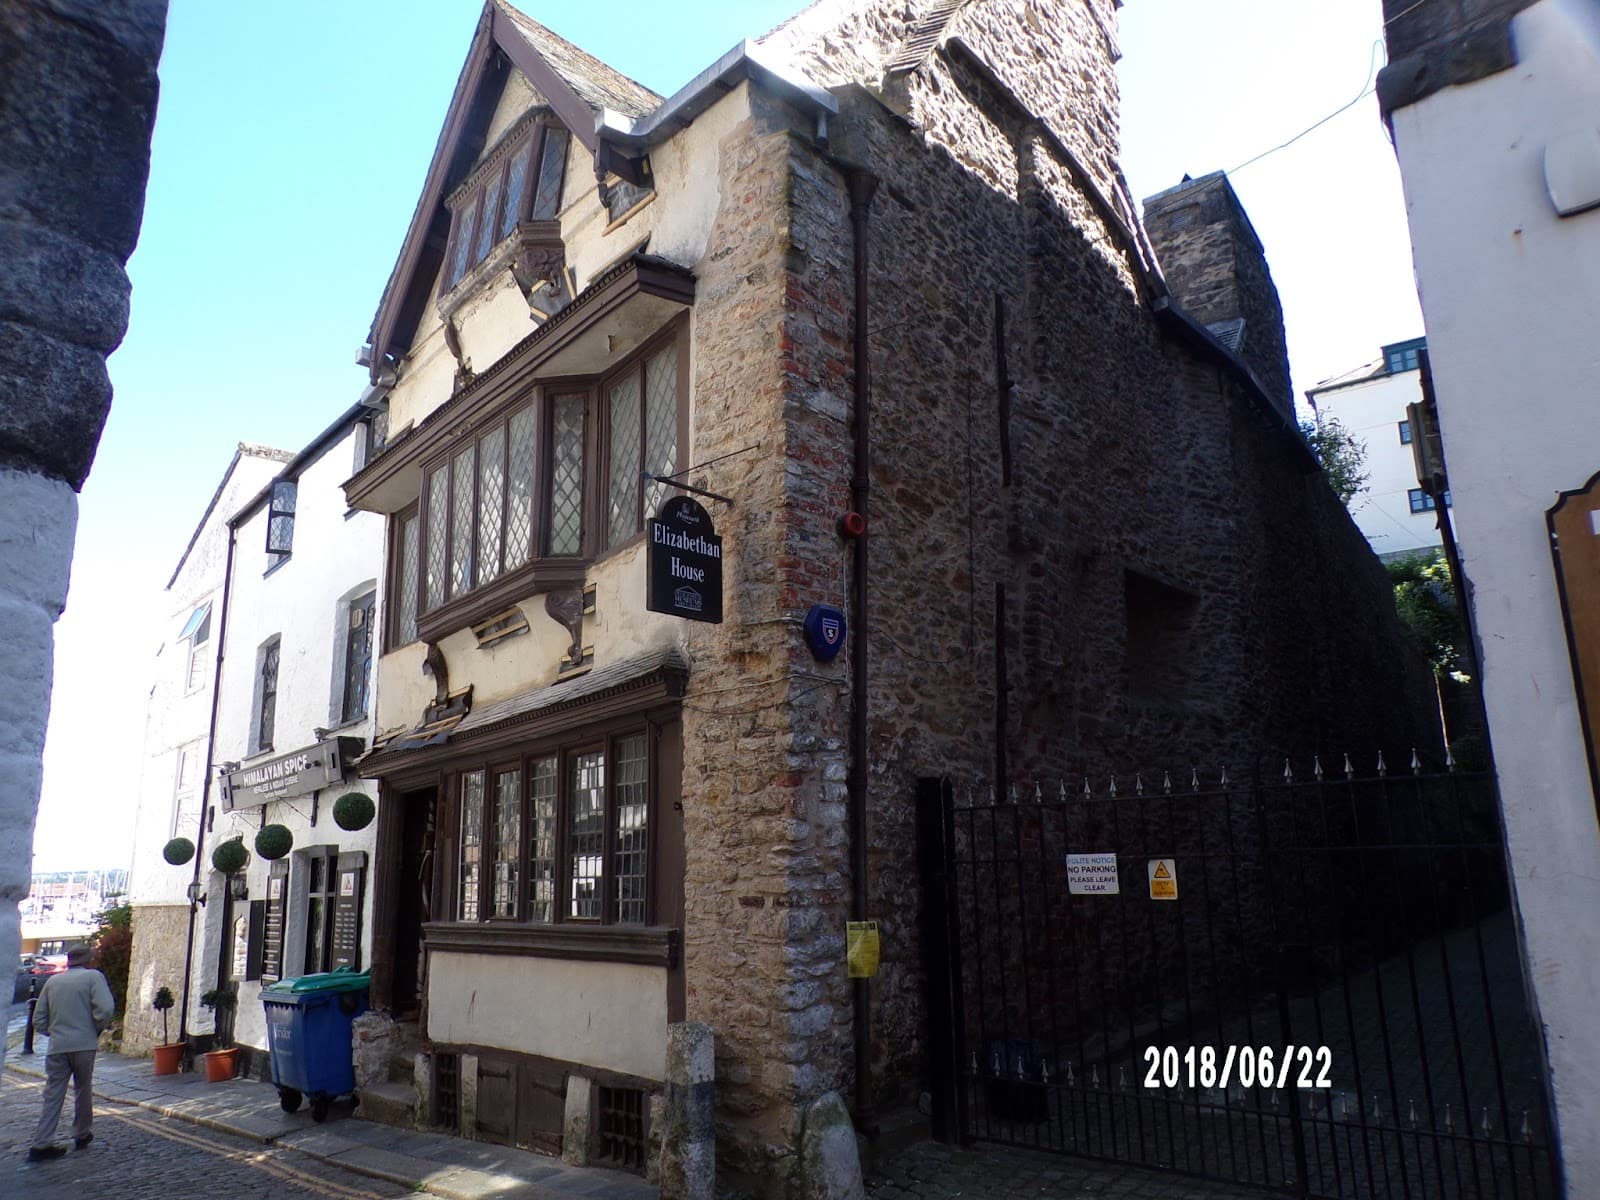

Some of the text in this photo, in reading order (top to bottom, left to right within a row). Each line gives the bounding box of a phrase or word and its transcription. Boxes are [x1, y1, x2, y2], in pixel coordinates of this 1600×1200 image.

[654, 522, 720, 558] Elizabethan
[671, 556, 705, 583] House
[243, 762, 283, 788] HIMALAYAN
[1068, 864, 1117, 873] NO PARKING
[1091, 856, 1116, 864] NOTICE
